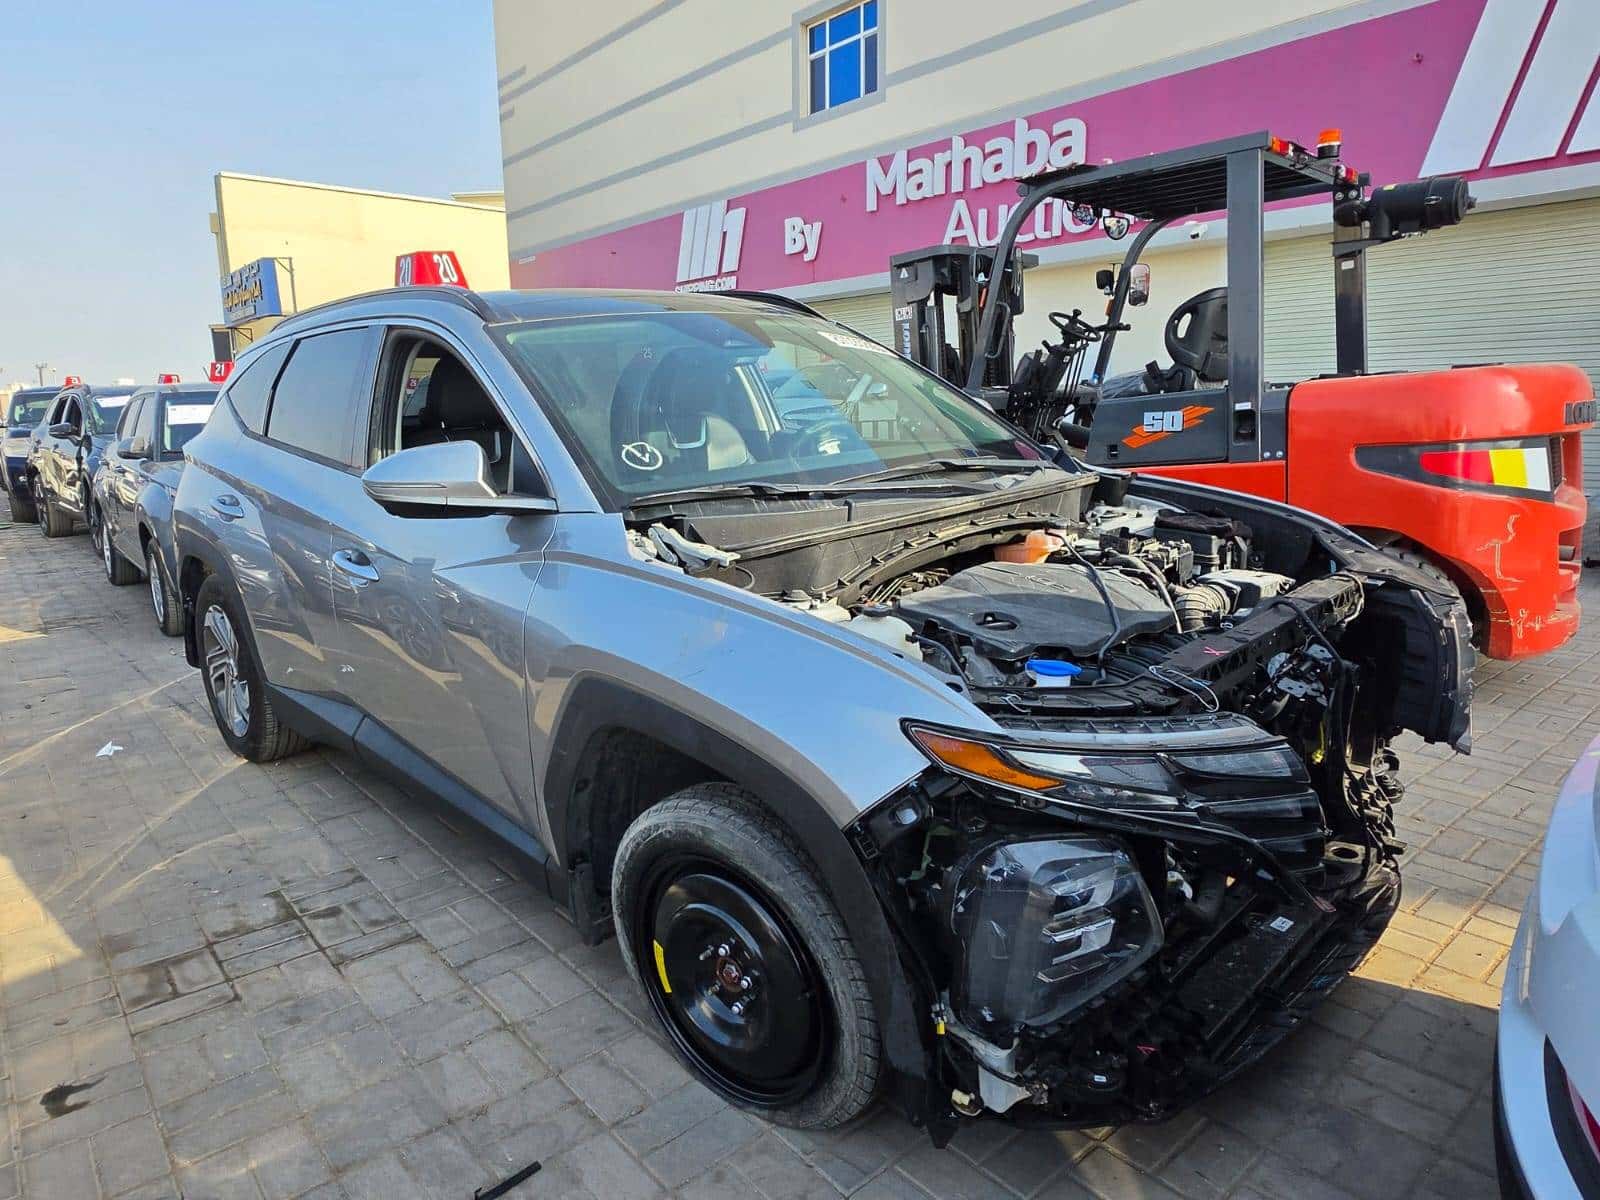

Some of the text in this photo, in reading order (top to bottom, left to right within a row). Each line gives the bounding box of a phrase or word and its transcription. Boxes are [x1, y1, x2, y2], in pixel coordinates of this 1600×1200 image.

[866, 117, 1087, 212] Marhaba
[784, 216, 822, 262] By
[400, 256, 412, 286] 20
[432, 253, 459, 283] 20
[215, 363, 225, 377] 21
[1143, 410, 1184, 433] 50
